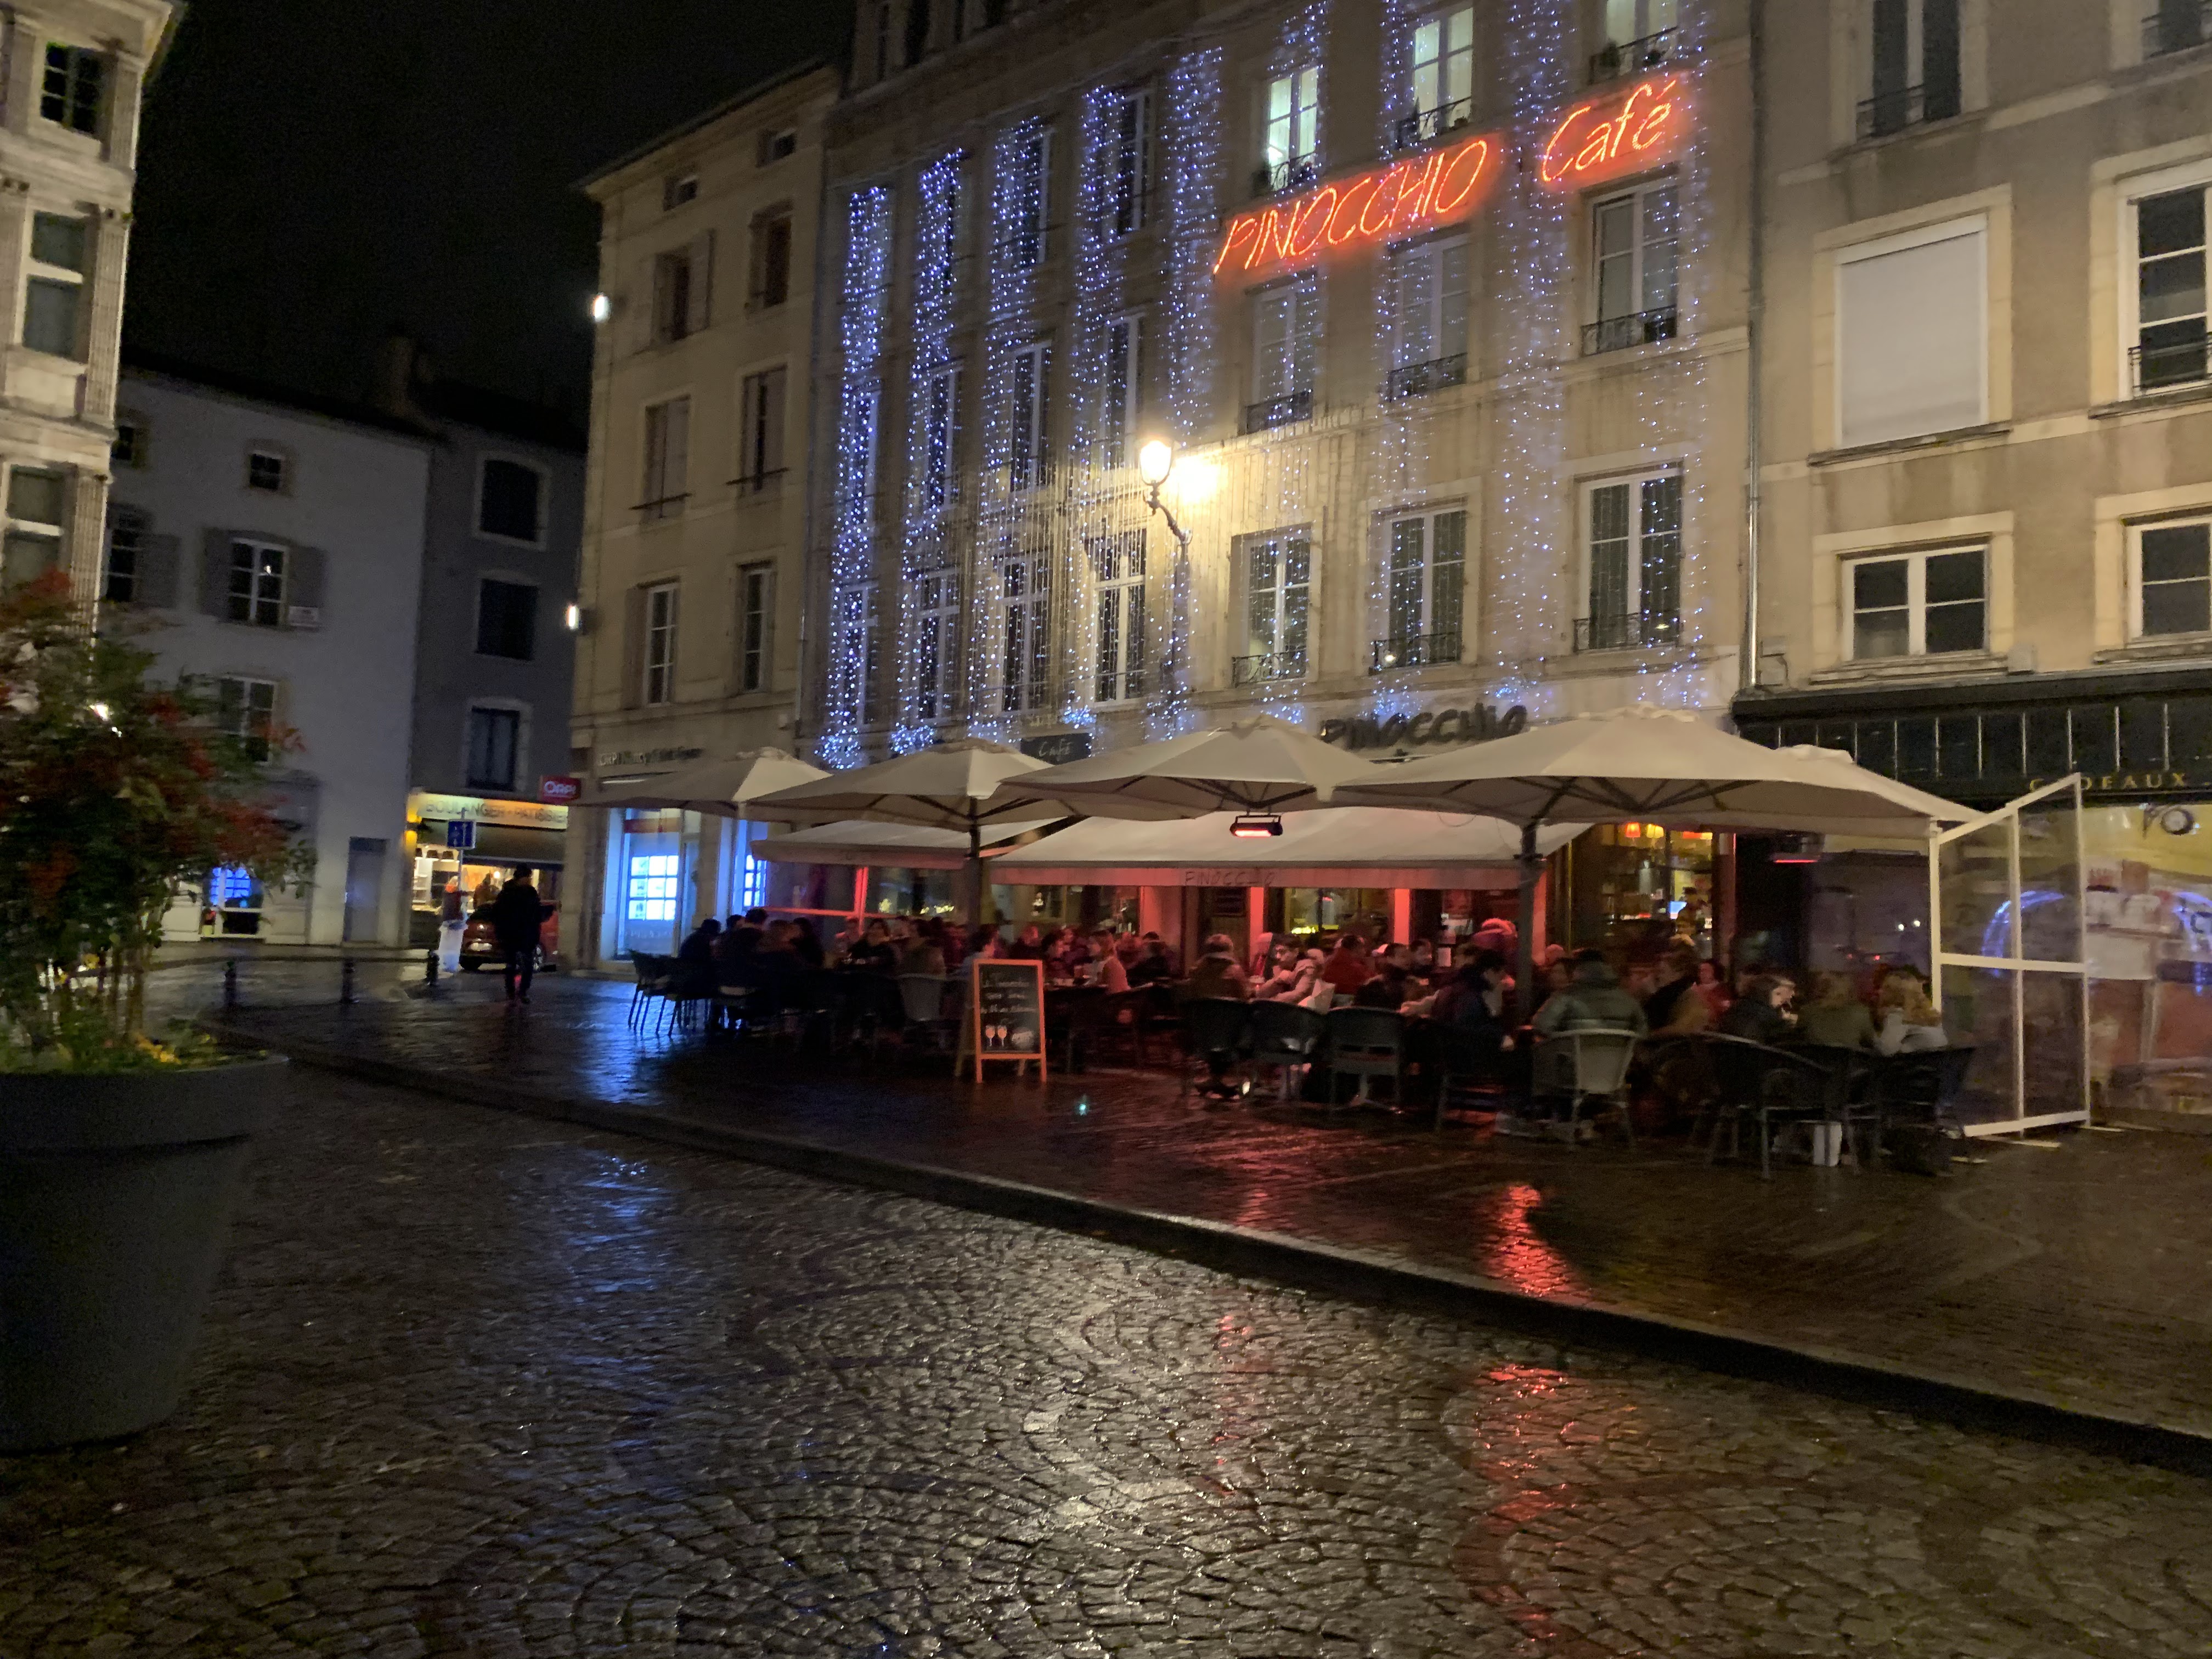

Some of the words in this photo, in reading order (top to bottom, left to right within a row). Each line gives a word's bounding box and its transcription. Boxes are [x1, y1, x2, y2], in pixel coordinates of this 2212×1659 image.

[1213, 139, 1488, 274] PINOCCHIO
[1541, 78, 1677, 182] Café
[2029, 772, 2185, 792] CDEAUX
